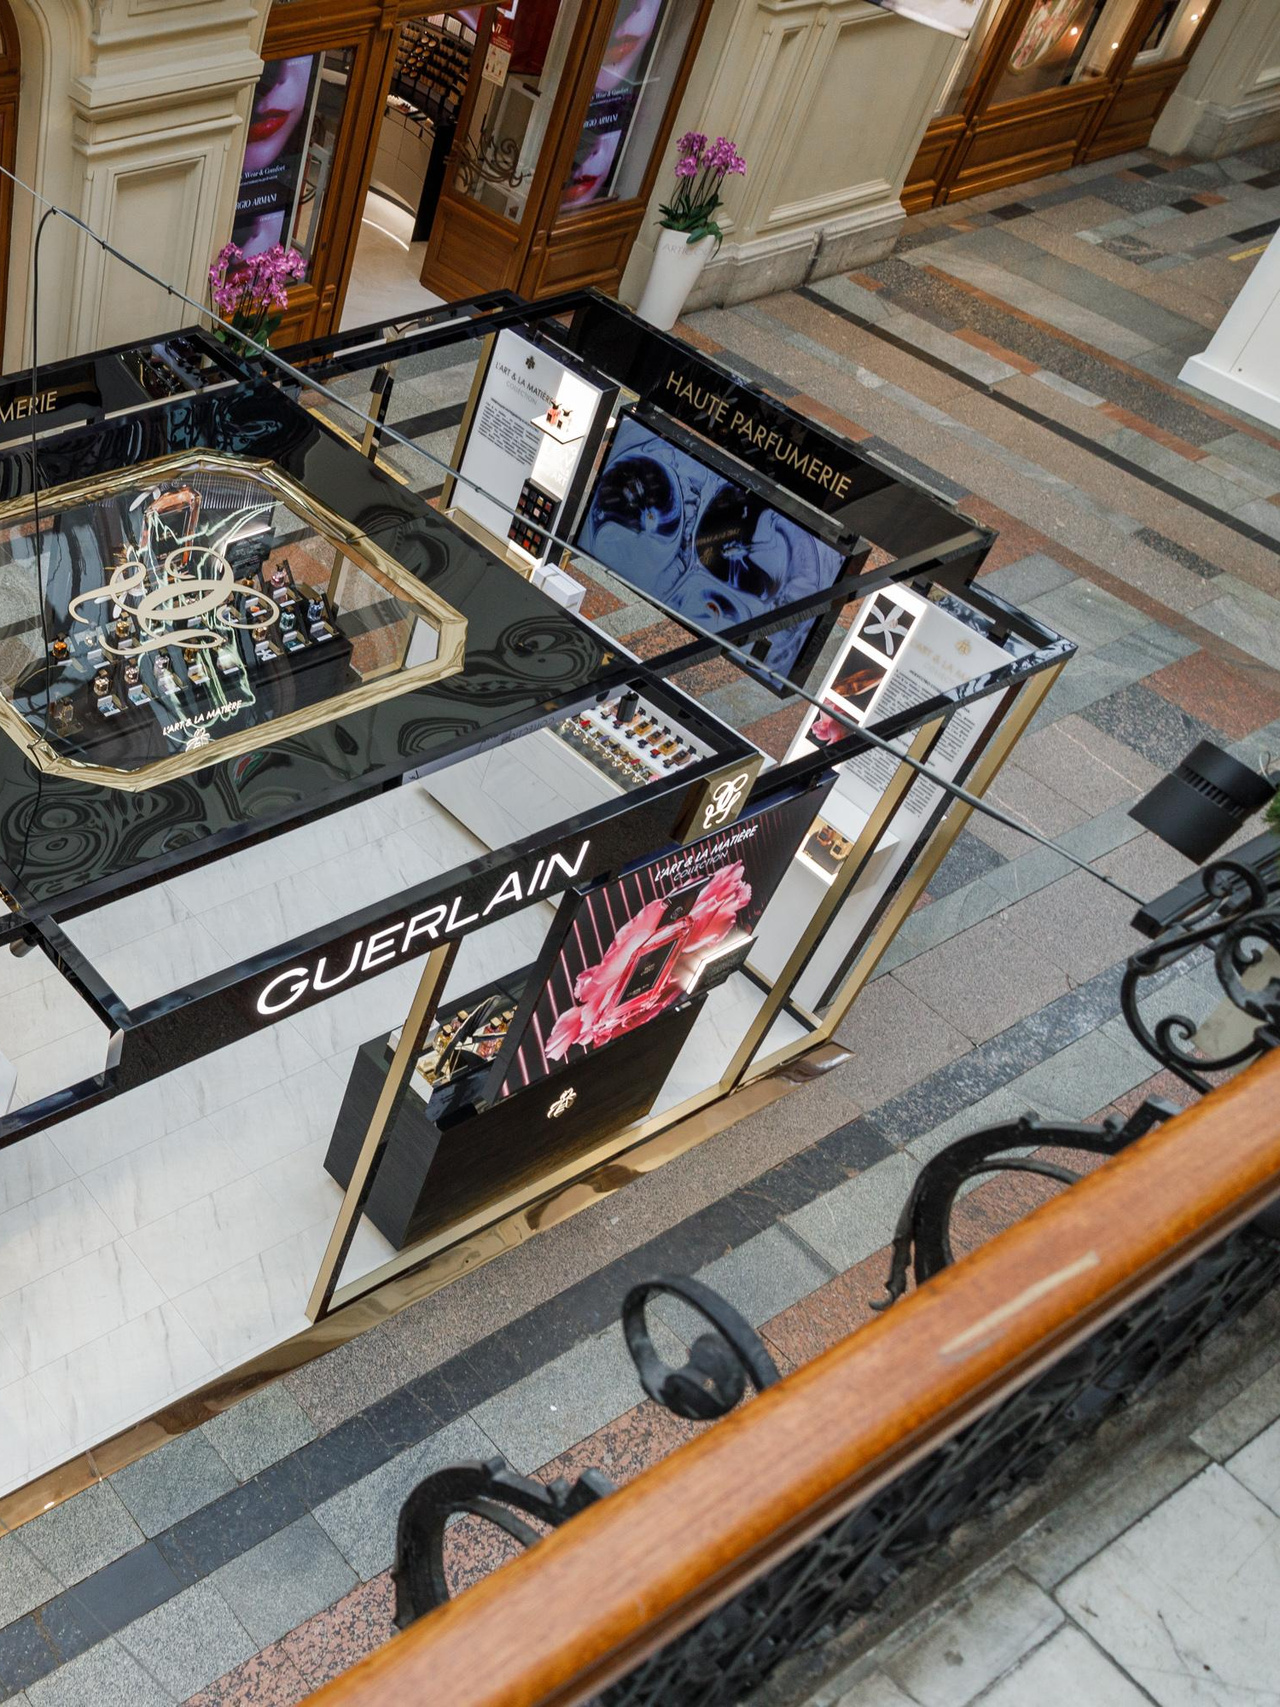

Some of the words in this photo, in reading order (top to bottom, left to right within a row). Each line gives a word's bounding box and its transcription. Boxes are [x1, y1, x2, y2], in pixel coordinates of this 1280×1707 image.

[666, 370, 730, 423] HAUTE
[730, 410, 852, 499] PARFUMERIE
[163, 721, 184, 735] L'ART
[185, 717, 192, 727] &
[194, 713, 205, 725] LA
[655, 859, 685, 882] L'ART
[683, 855, 694, 867] &
[694, 847, 708, 861] LA
[710, 825, 759, 856] MATIÈRE
[673, 849, 729, 882] COLLECTION
[256, 840, 591, 1015] GUERLAIN
